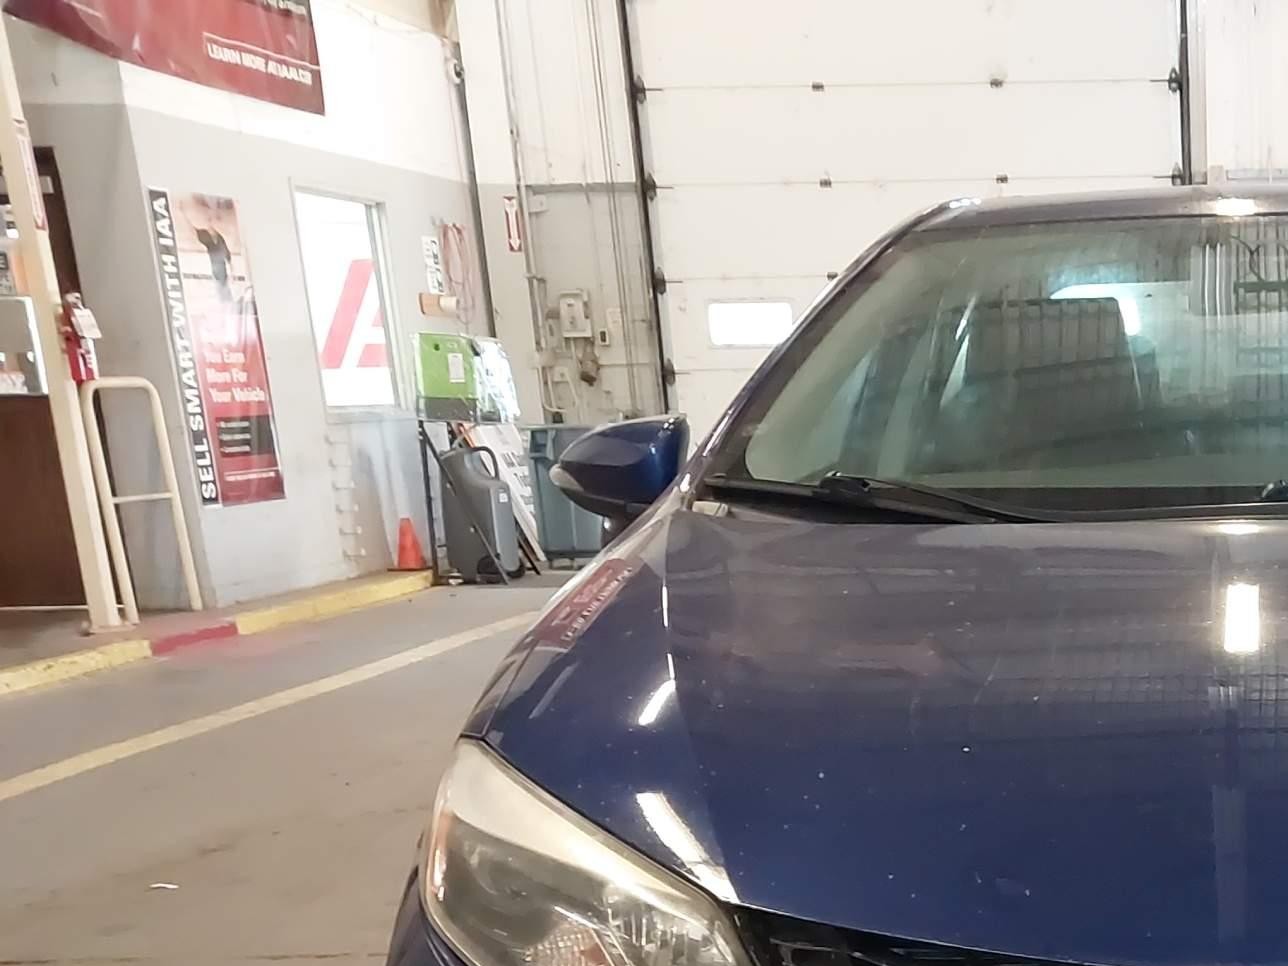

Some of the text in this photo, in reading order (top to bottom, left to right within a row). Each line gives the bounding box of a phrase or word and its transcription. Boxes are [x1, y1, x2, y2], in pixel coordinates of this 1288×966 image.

[152, 197, 218, 500] SELL SMART WITH IAA
